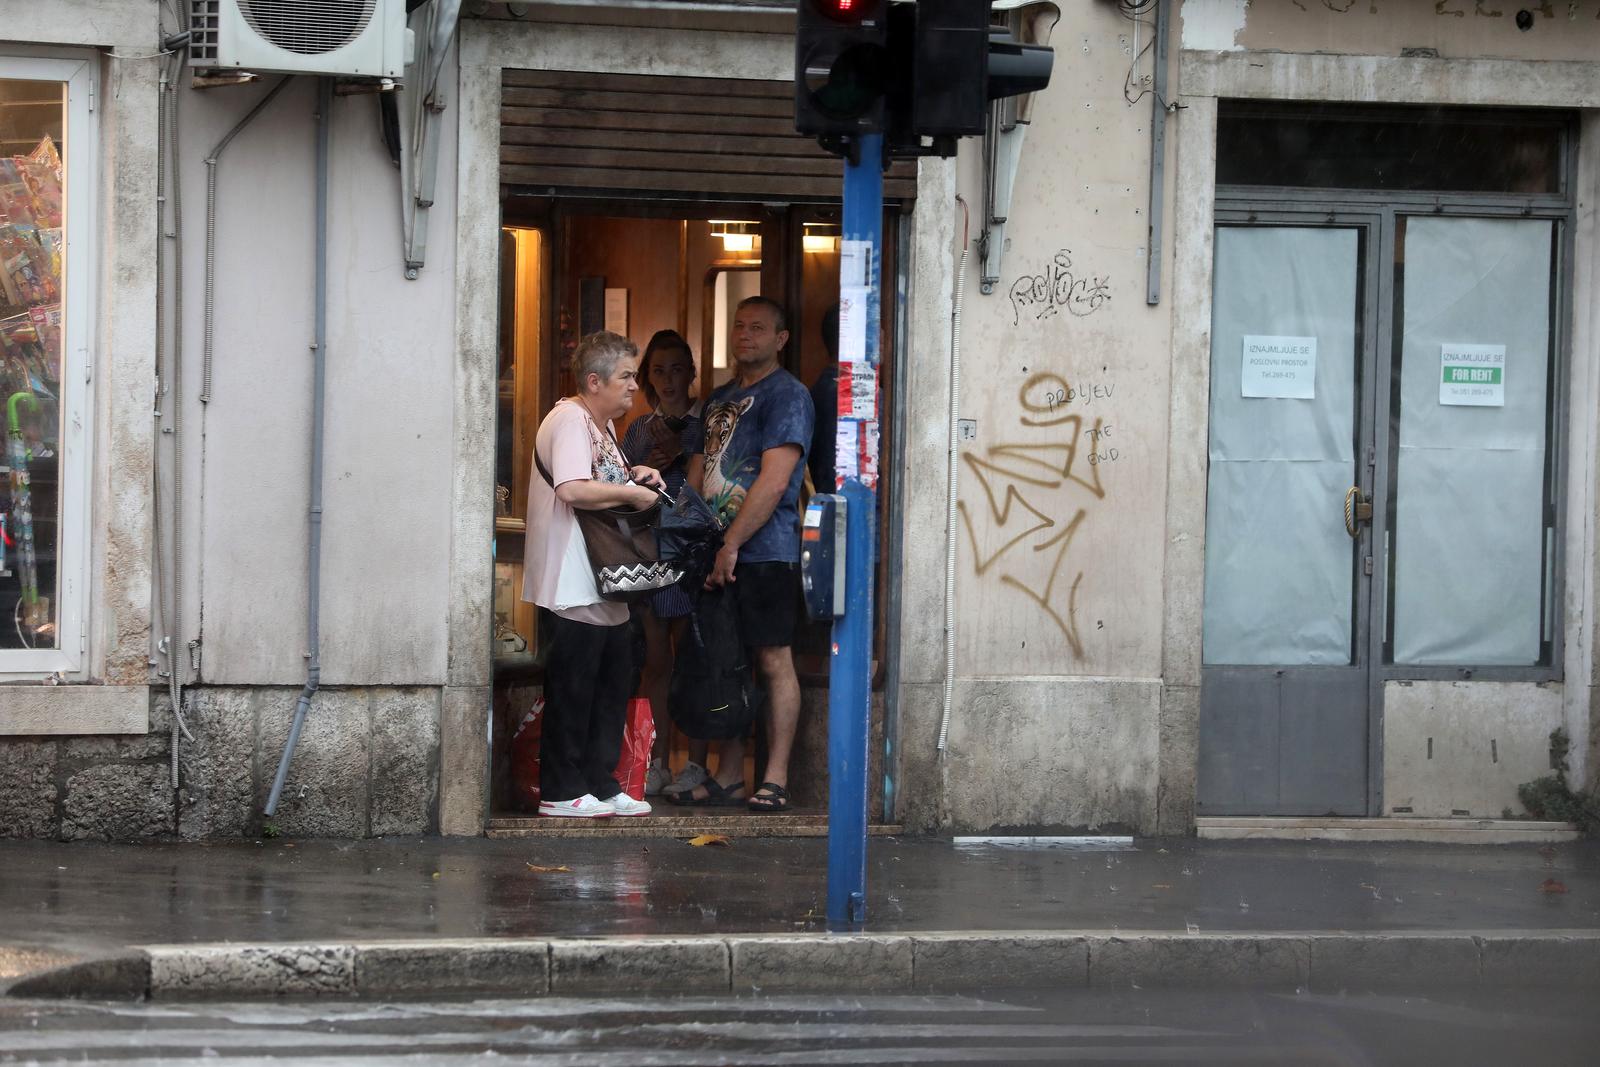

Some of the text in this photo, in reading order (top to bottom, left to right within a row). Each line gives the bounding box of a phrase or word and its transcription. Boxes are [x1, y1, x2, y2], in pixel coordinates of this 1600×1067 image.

[1249, 344, 1310, 354] IZNAJMLJUJE SE
[1281, 359, 1308, 367] PROSTOR
[1443, 352, 1504, 362] IZNAJMLJUJE SE
[1452, 368, 1493, 382] FOR RENT
[1085, 425, 1113, 441] THE
[1087, 448, 1119, 466] END
